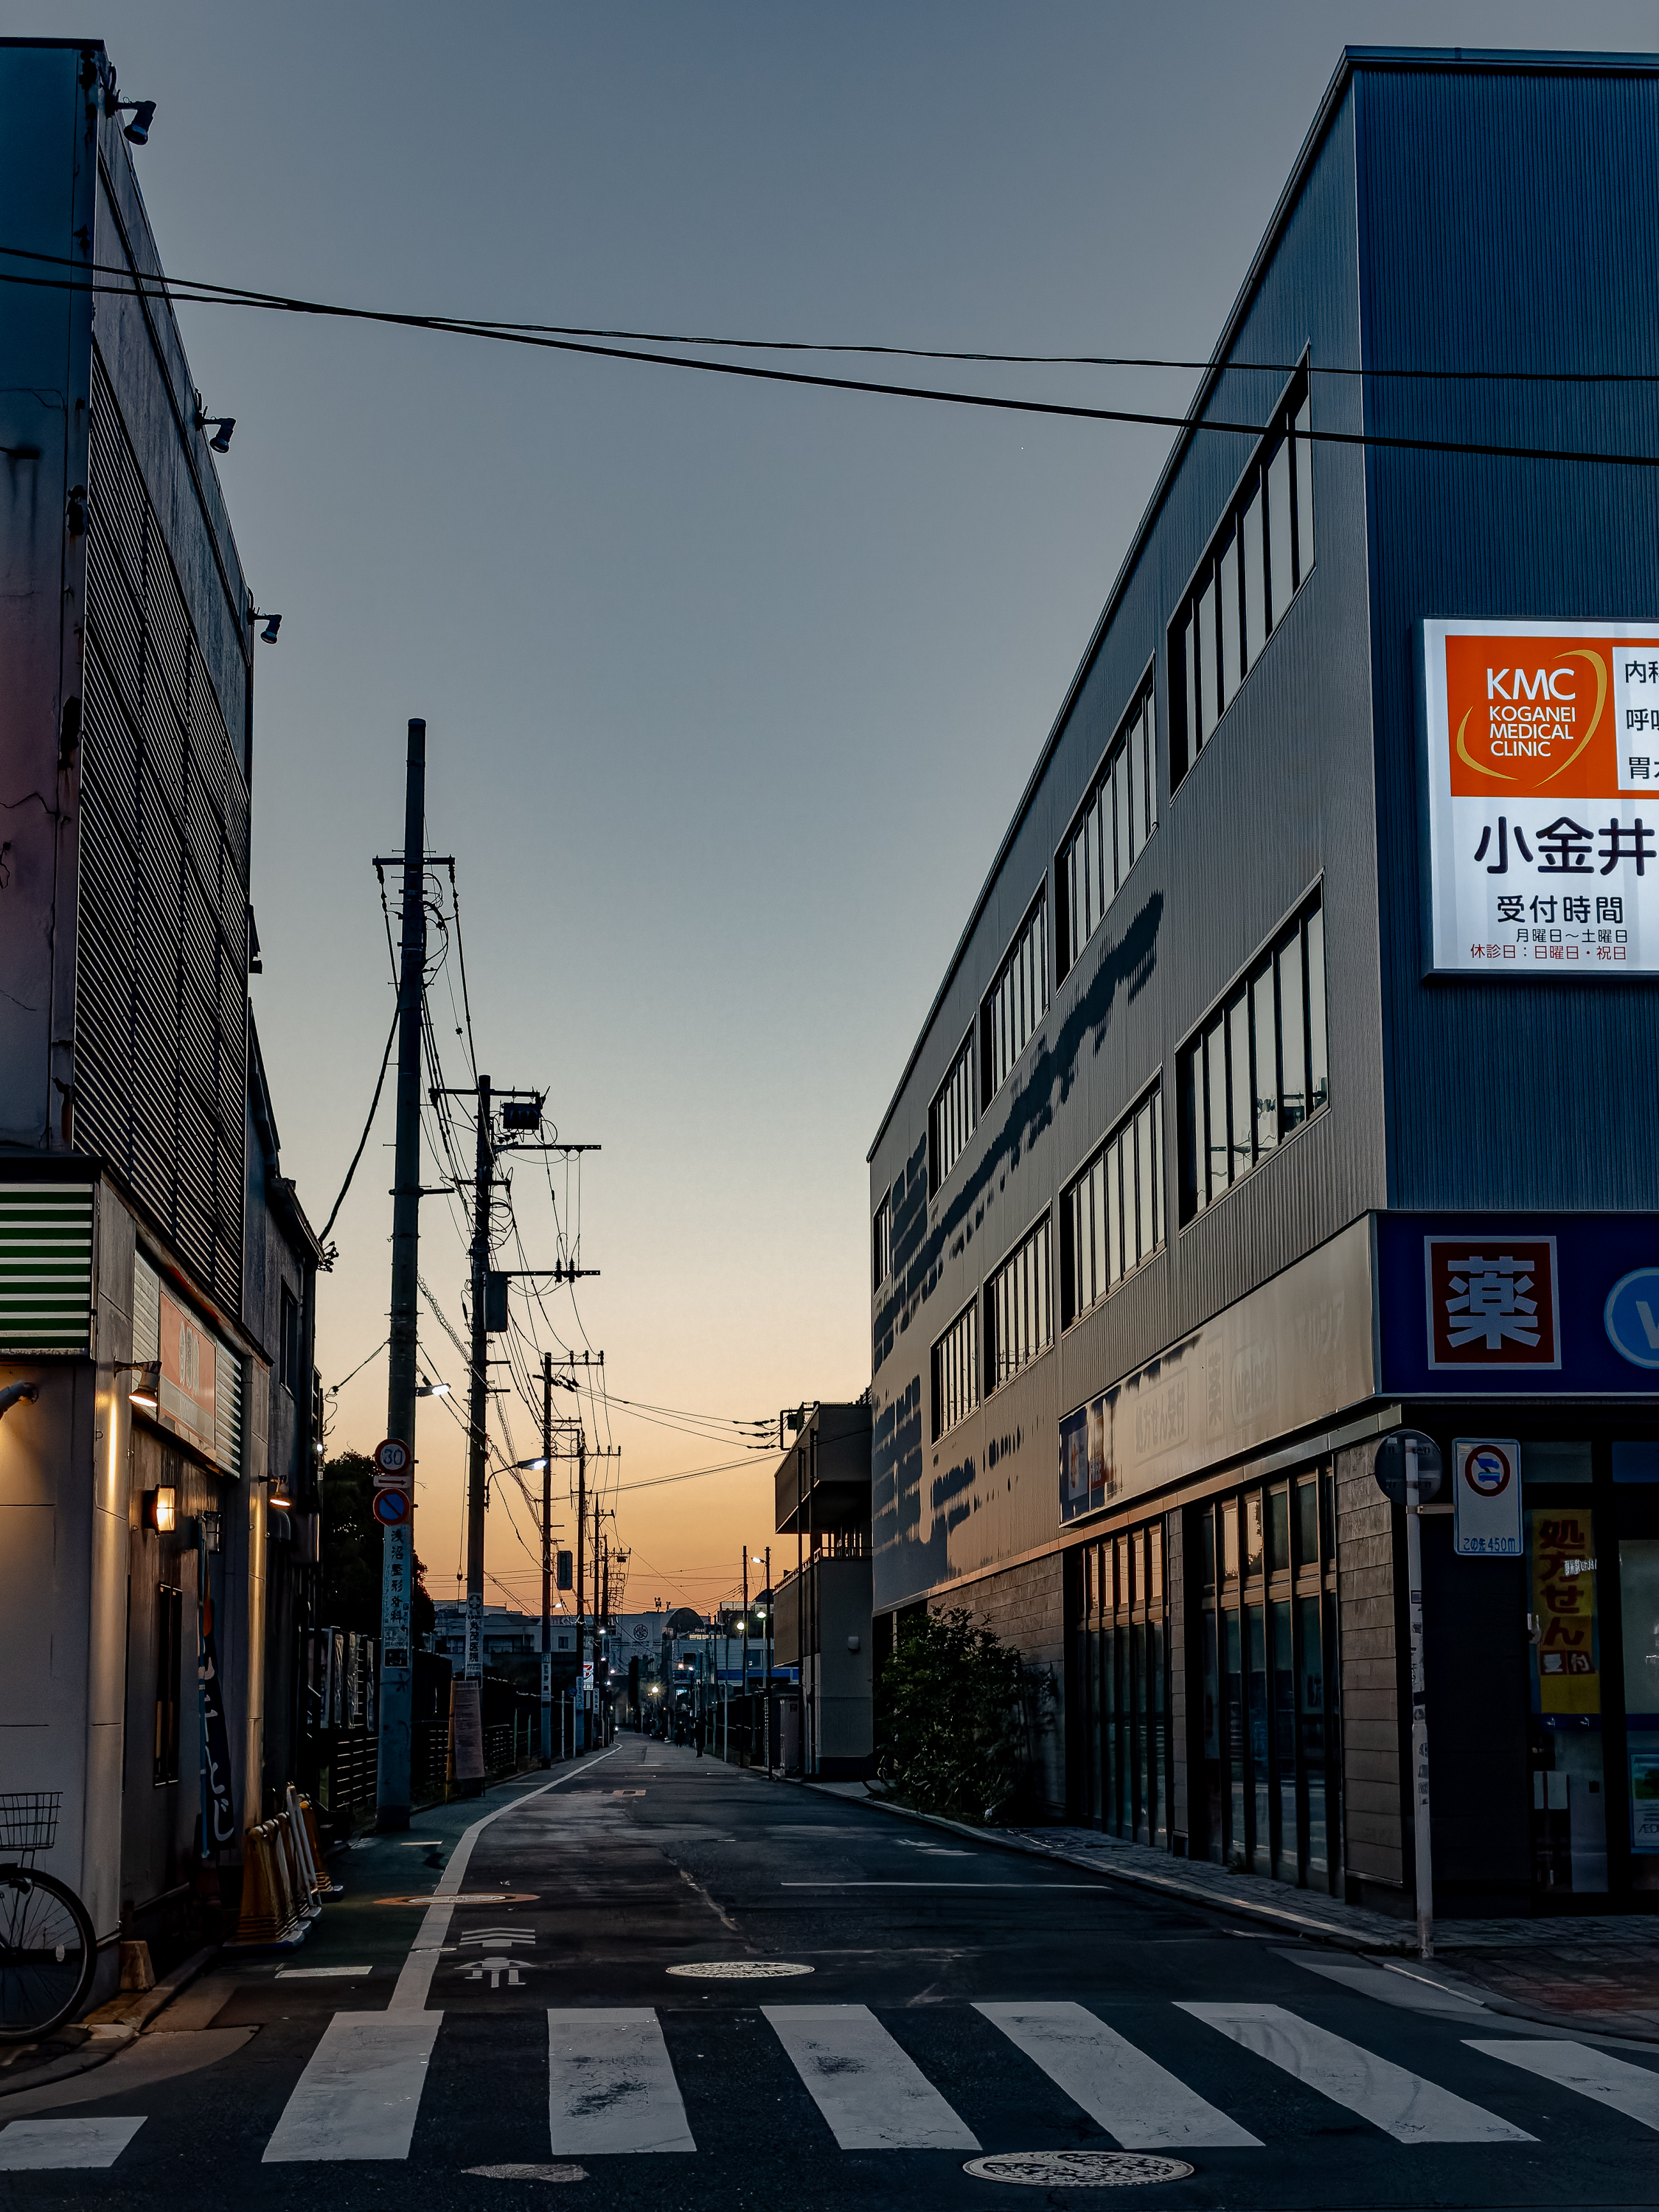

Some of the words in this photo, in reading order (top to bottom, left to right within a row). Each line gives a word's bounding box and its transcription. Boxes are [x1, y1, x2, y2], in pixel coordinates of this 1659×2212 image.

[1486, 668, 1576, 700] KMC
[1489, 706, 1576, 722] KOGANEI
[1489, 723, 1574, 740] MEDICAL
[1490, 740, 1551, 757] CLINIC
[1629, 757, 1659, 779] 胃
[1474, 816, 1658, 876] 小金井
[1497, 894, 1624, 924] 受付時間
[1445, 1256, 1541, 1349] 薬
[383, 1448, 404, 1466] 30
[1539, 1519, 1585, 1646] 処方せん
